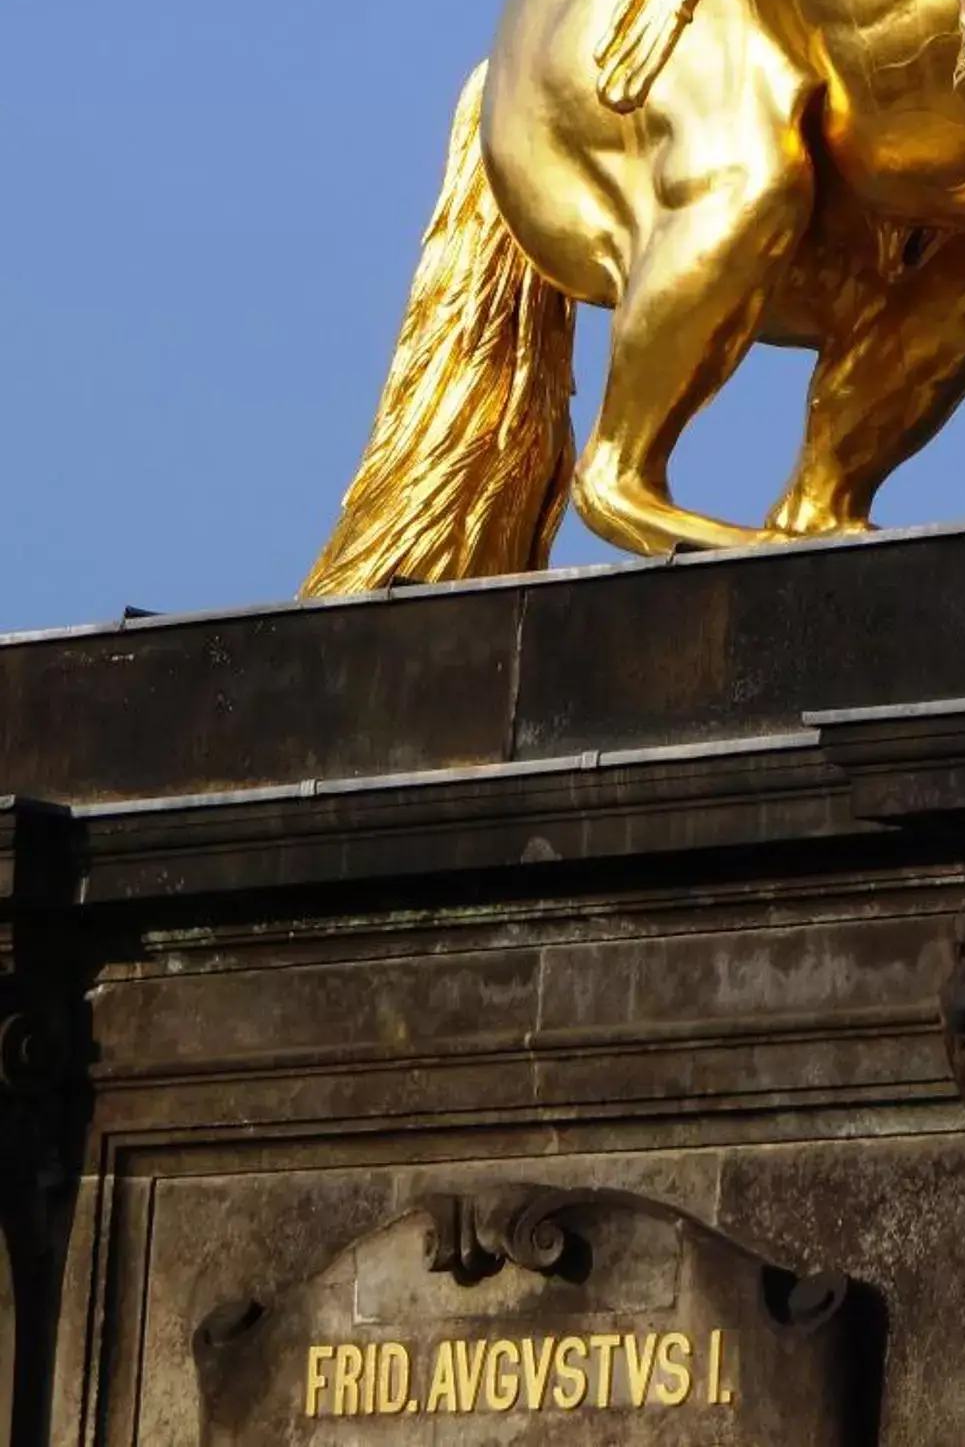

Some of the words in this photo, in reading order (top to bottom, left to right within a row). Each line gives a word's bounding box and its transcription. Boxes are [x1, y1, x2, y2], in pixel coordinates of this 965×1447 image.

[305, 1340, 418, 1417] FRID.
[426, 1332, 692, 1412] AVGVSTVS
[707, 1329, 733, 1406] I.
